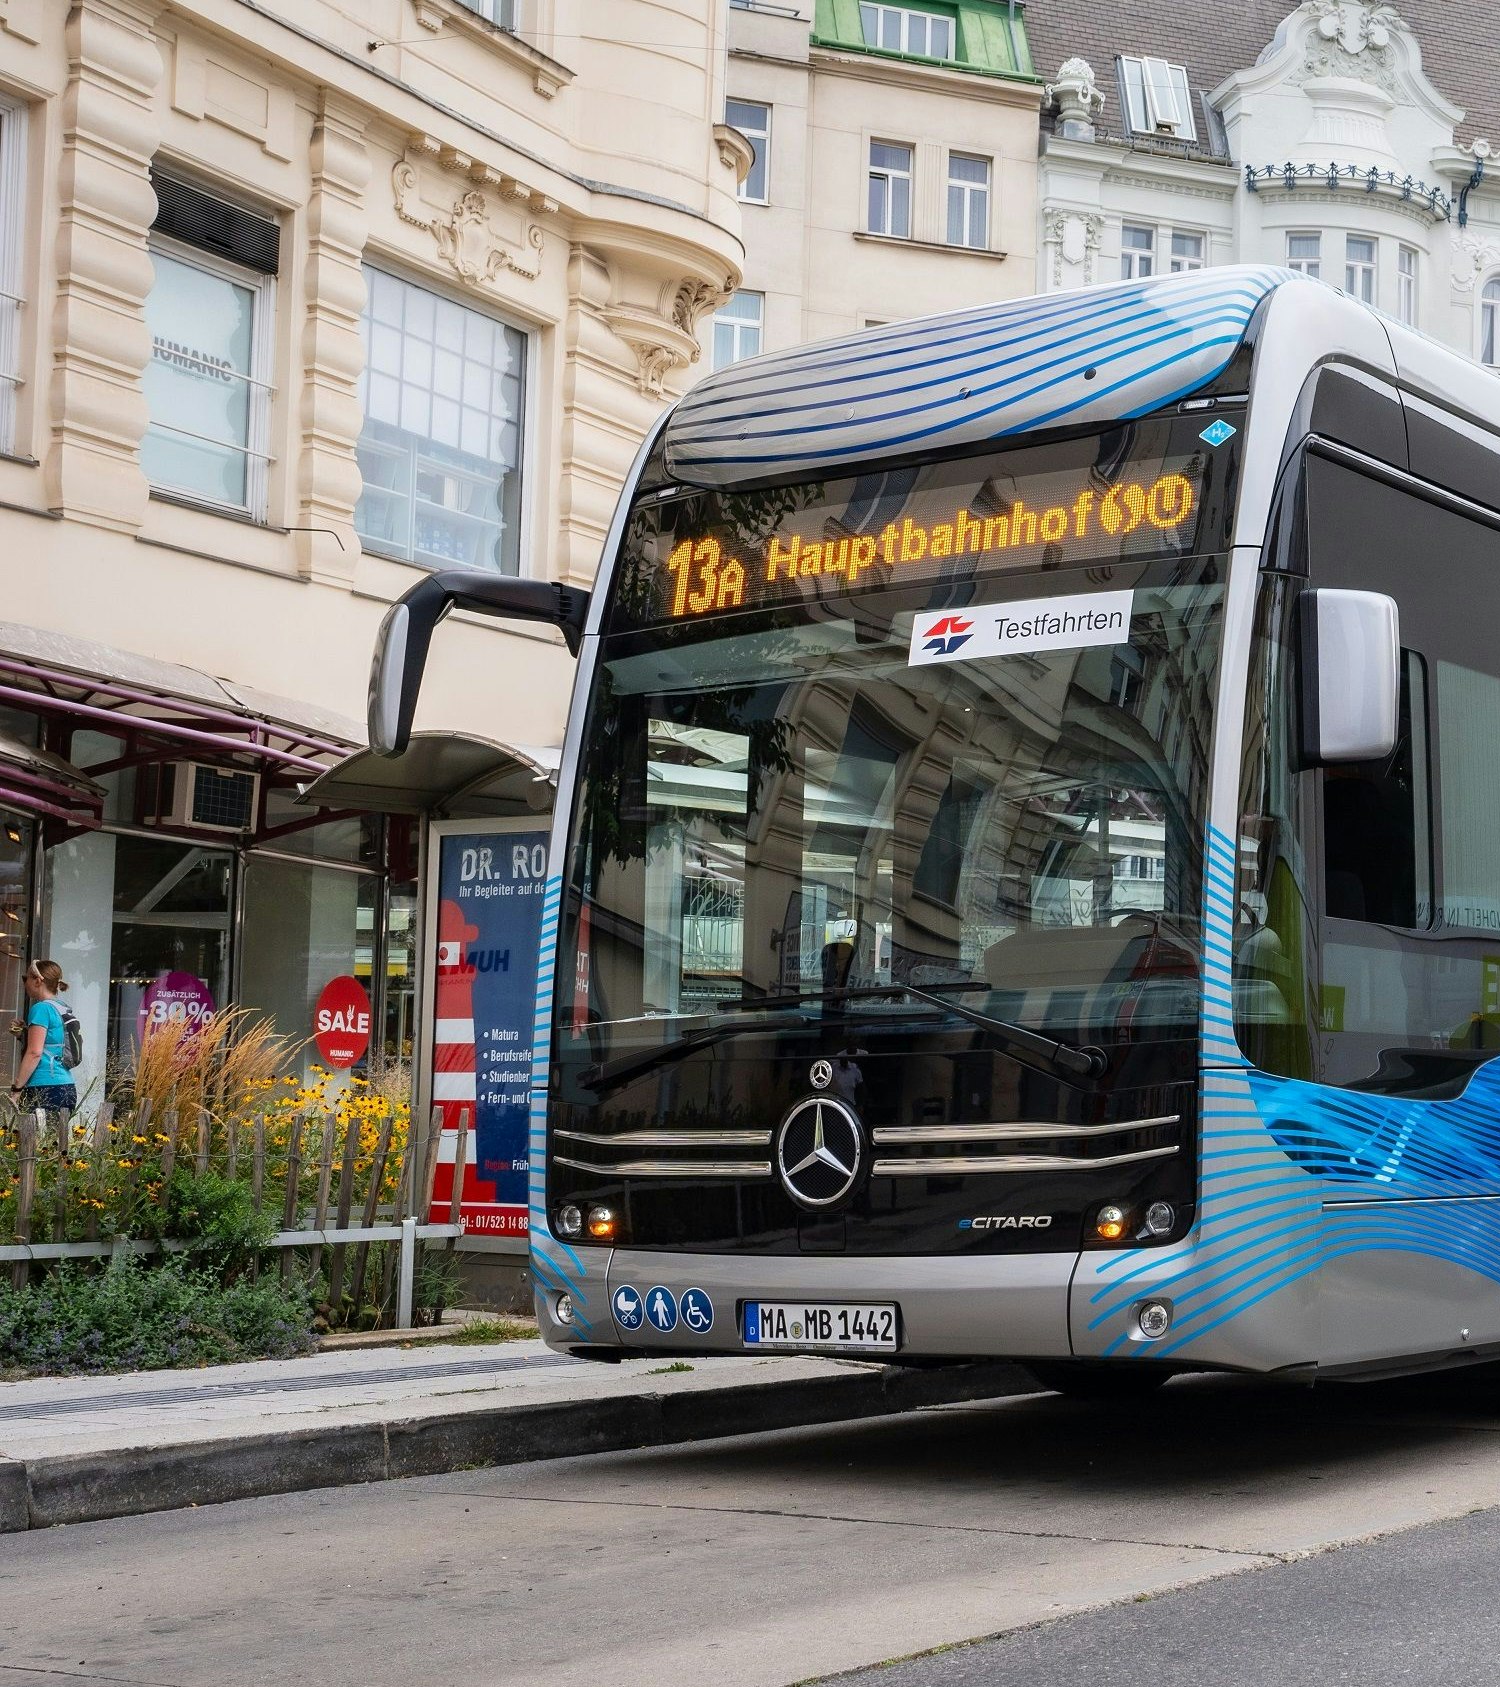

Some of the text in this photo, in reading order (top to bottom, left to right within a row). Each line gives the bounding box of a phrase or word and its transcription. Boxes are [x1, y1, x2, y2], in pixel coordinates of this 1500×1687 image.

[668, 538, 746, 616] 13A
[767, 489, 1095, 582] Hauptbahnhof
[995, 609, 1123, 640] Testfahrten
[460, 844, 546, 882] DR. RO
[459, 886, 472, 898] Ihr
[474, 884, 515, 899] Begleiter
[518, 883, 532, 896] auf
[157, 990, 200, 999] ZUSÄTZLICH
[491, 1028, 519, 1041] Matura
[329, 1049, 354, 1058] HUMANIC
[489, 1070, 530, 1083] Studienber
[487, 1091, 510, 1104] Fern-
[512, 1091, 526, 1104] und
[512, 1159, 529, 1171] Früh
[475, 1215, 506, 1229] 01/523
[508, 1216, 516, 1229] 14
[518, 1216, 529, 1230] 88
[959, 1215, 1053, 1229] eCITARO
[750, 1308, 894, 1342] D MA MB 1442
